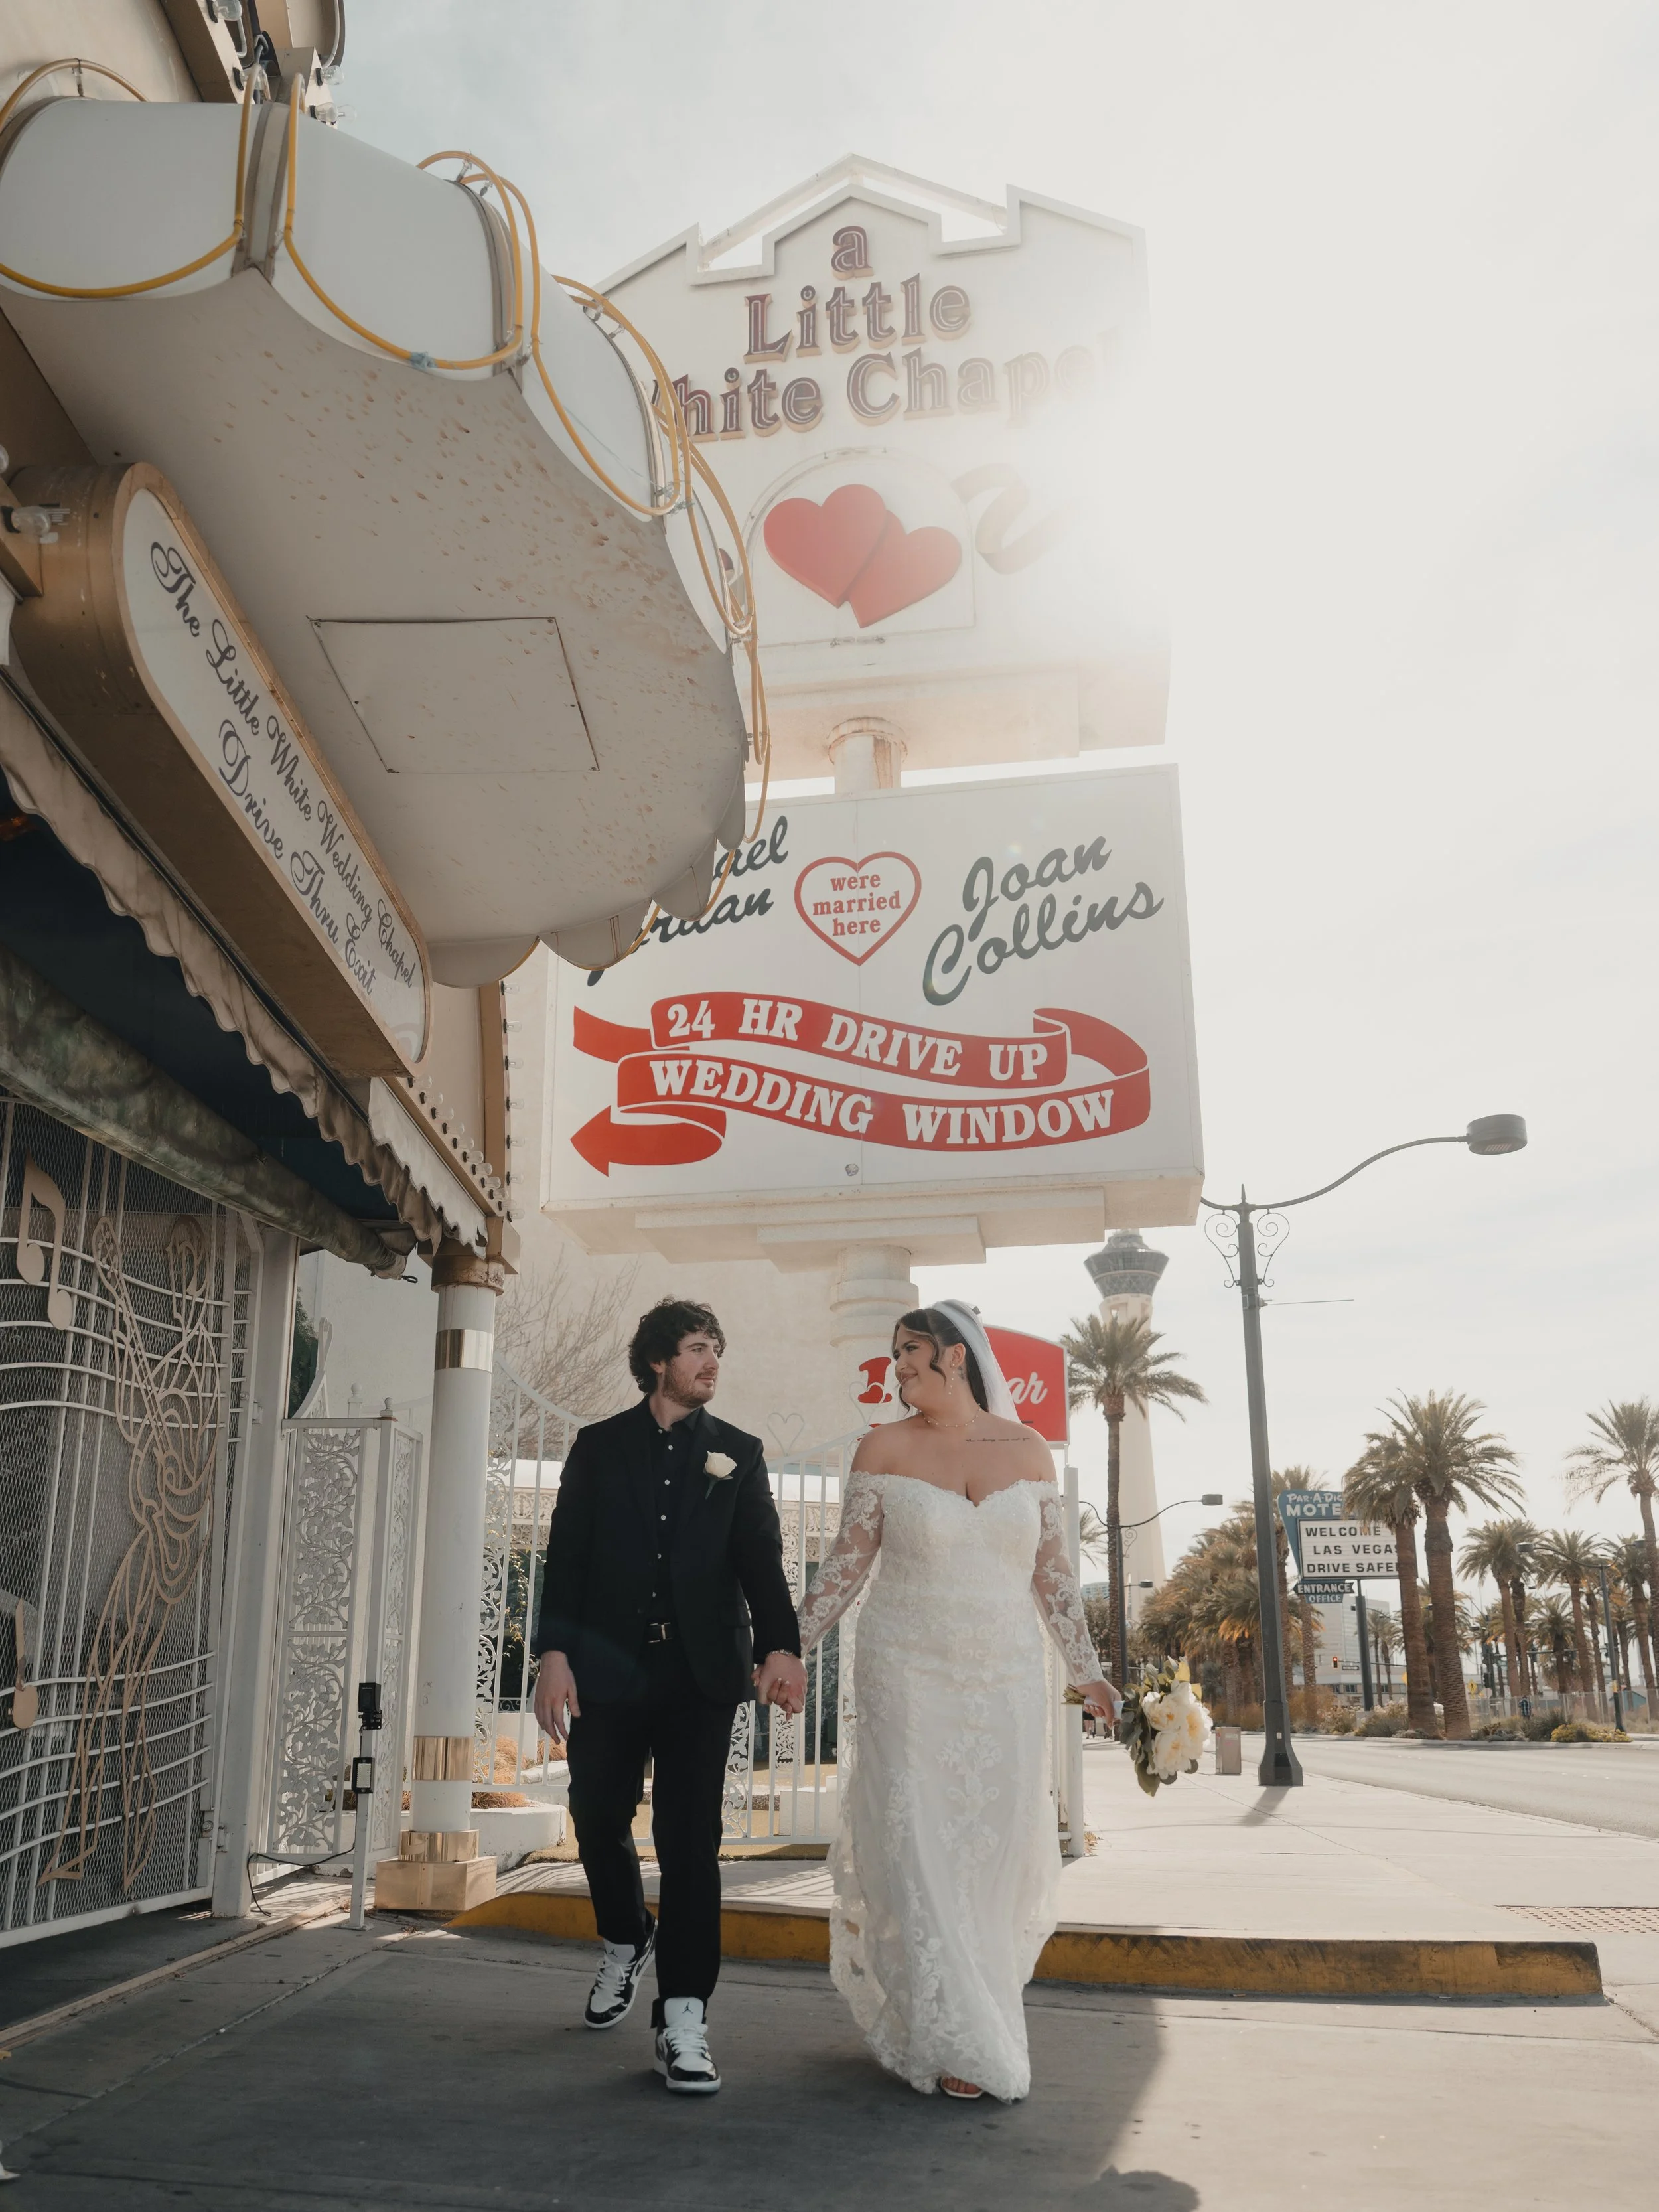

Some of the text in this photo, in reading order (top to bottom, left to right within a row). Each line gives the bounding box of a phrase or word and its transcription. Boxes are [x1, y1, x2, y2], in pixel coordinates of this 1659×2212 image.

[831, 226, 874, 280] a
[743, 273, 971, 364] Little
[652, 367, 824, 442] hite
[151, 542, 416, 988] The Little White Wedding Chapel
[219, 719, 376, 995] Drive Thru Exit
[830, 874, 881, 891] were
[813, 890, 901, 915] married
[962, 836, 1112, 942] Joan
[832, 917, 881, 936] here
[923, 882, 1164, 1006] Collins
[668, 999, 1048, 1081] 24 HR DRIVE UP
[650, 1060, 1114, 1144] WEDDING WINDOW
[1286, 1503, 1343, 1517] MOTE
[1307, 1563, 1350, 1573] DRIVE
[1313, 1545, 1342, 1554] LAS
[1297, 1583, 1351, 1593] ENTRANCE
[1309, 1594, 1342, 1603] OFFICE
